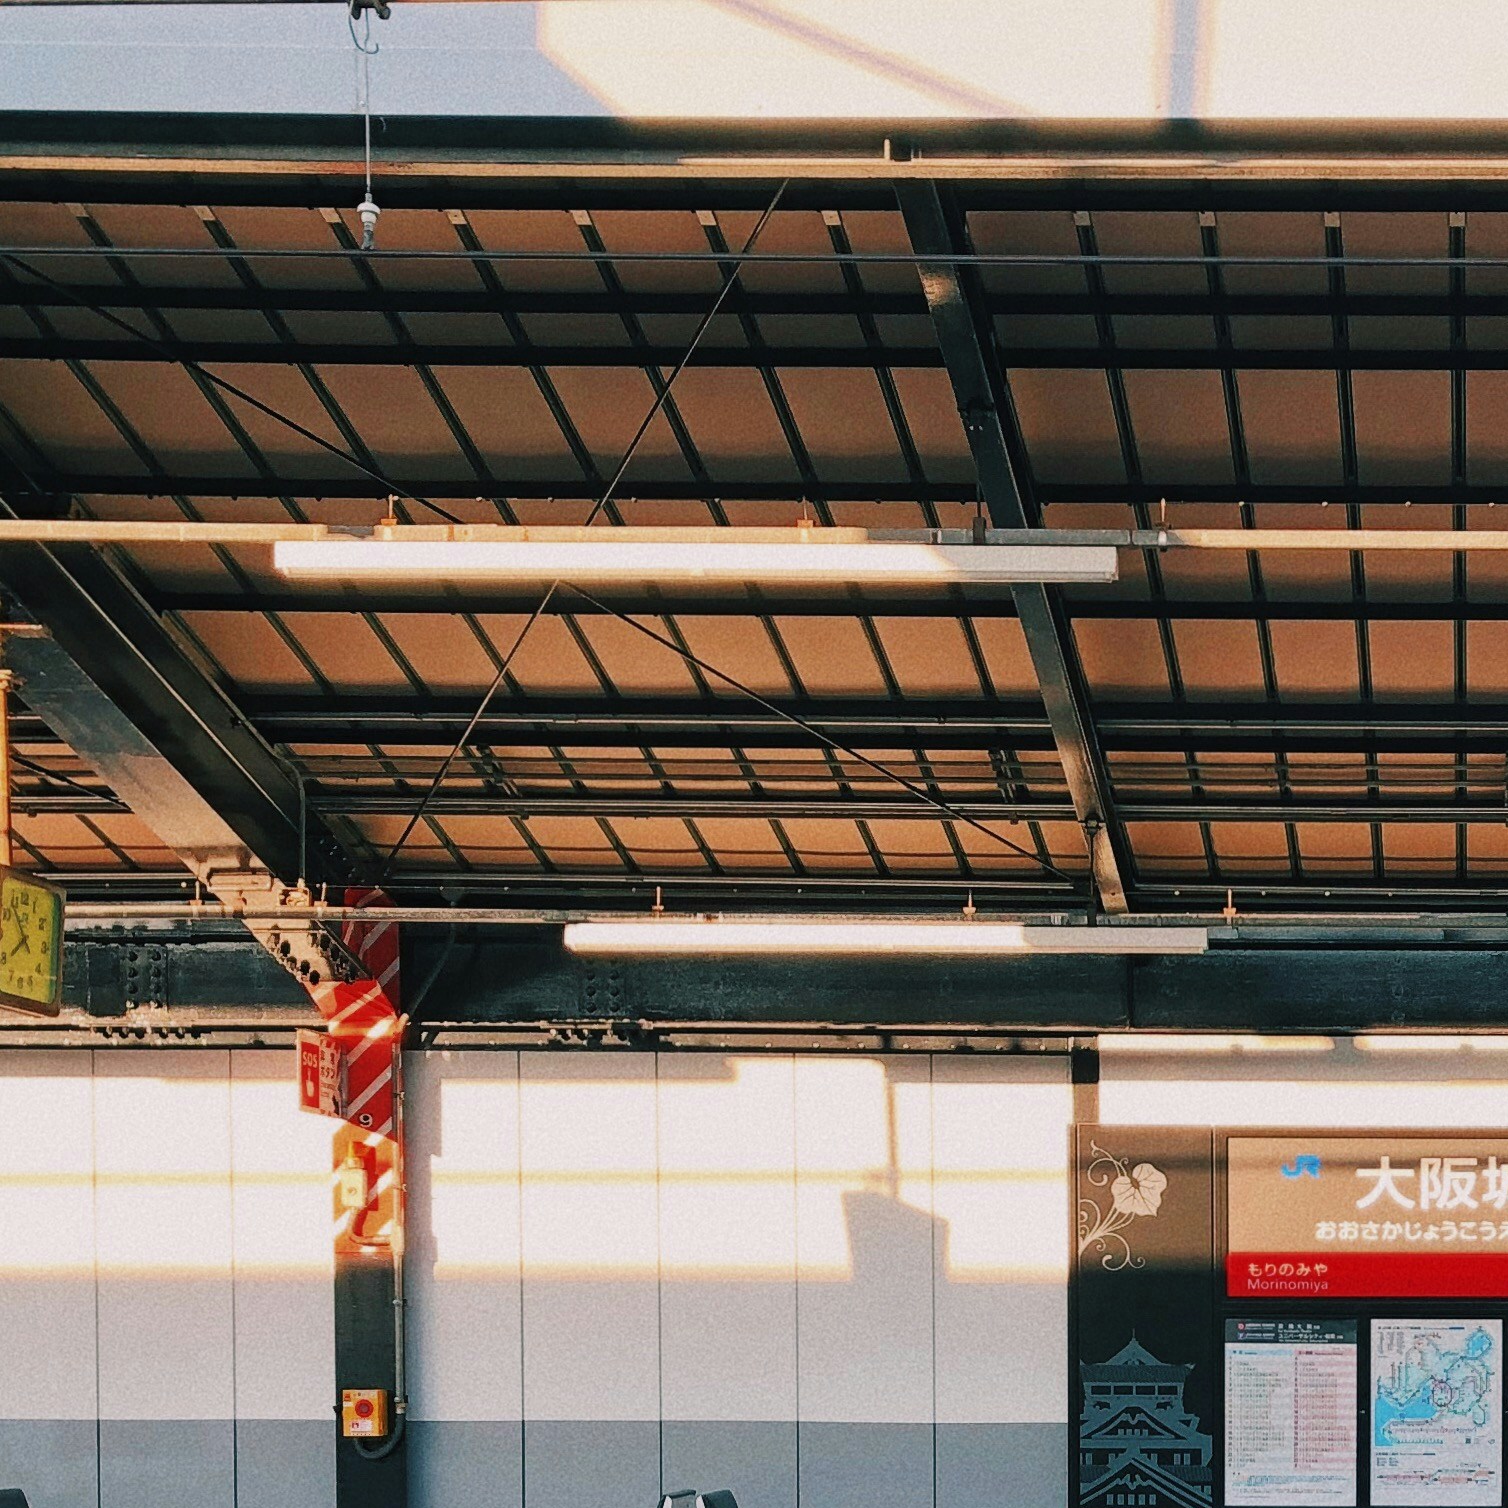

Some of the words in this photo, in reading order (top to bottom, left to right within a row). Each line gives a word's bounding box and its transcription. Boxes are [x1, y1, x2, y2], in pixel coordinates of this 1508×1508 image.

[302, 1051, 318, 1069] SOS
[359, 1113, 373, 1128] 9
[1281, 1154, 1322, 1179] JR
[1247, 1262, 1329, 1277] もりのみや
[1247, 1278, 1329, 1294] Morinomiya
